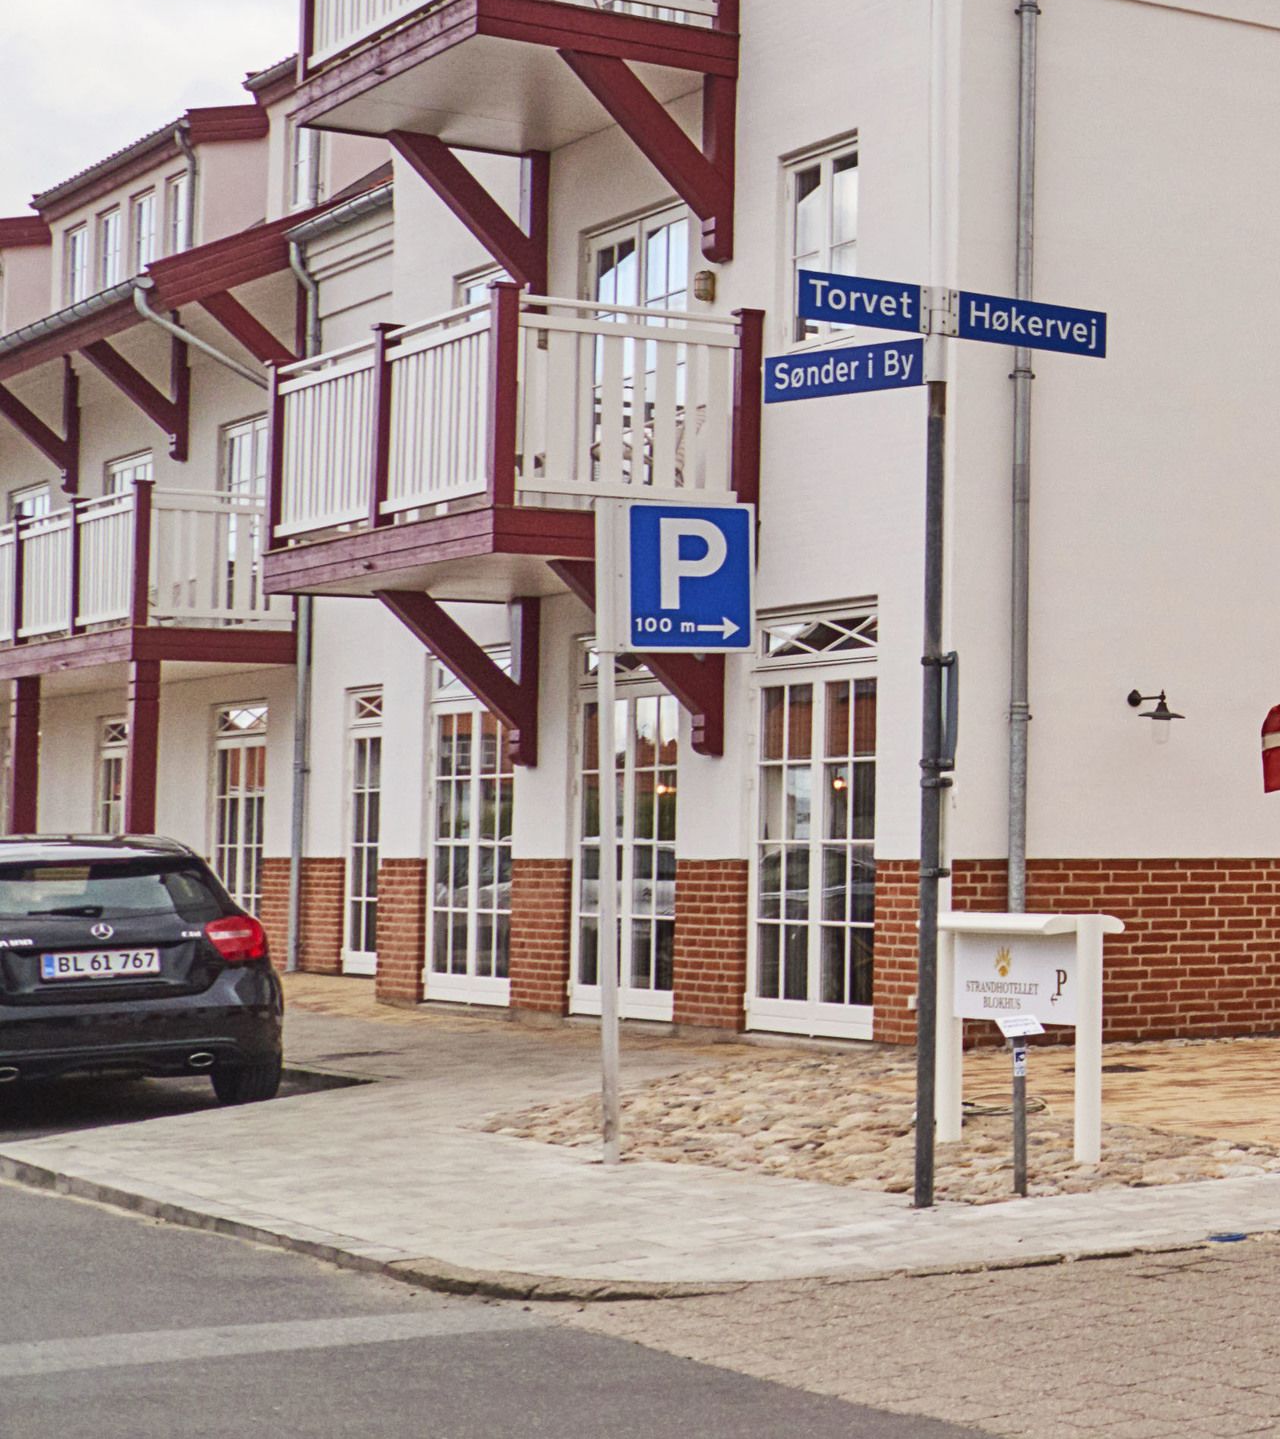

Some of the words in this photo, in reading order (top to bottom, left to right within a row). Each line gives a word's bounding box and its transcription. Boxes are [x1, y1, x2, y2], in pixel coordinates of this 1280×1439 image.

[808, 278, 913, 320] Torvet
[969, 300, 1098, 350] Høkervej
[773, 357, 859, 391] Sønder
[866, 353, 873, 379] i
[883, 349, 915, 380] By
[659, 517, 728, 610] P
[635, 617, 672, 633] 100
[680, 621, 695, 633] m
[58, 956, 84, 973] BL
[90, 954, 113, 972] 61
[119, 951, 155, 970] 767
[966, 980, 1039, 995] STRANDHOTELLET
[1056, 970, 1068, 996] P
[983, 996, 1021, 1009] BLOKHUS
